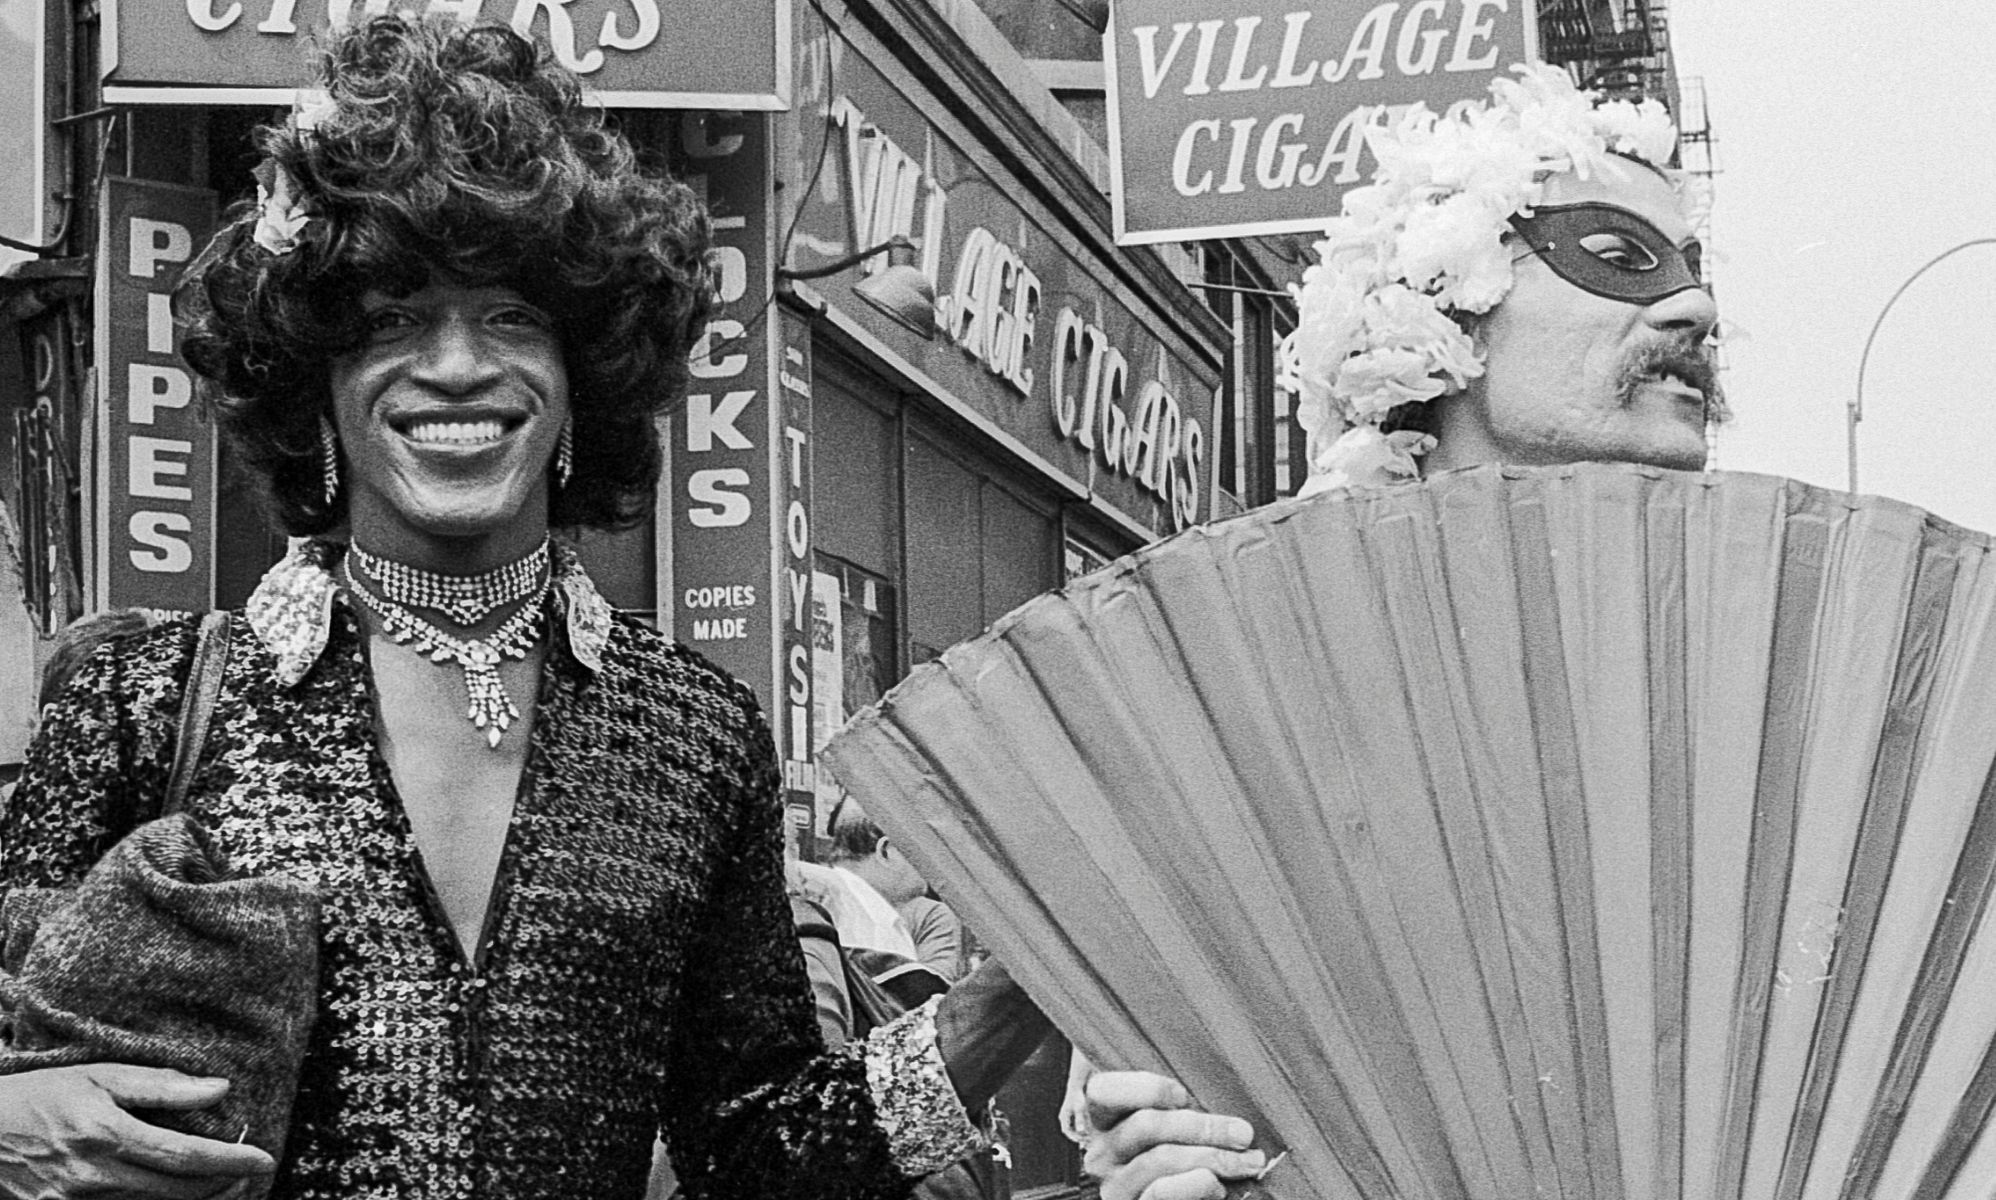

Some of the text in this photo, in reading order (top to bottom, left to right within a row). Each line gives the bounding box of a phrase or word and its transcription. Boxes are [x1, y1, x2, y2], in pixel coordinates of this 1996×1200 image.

[1133, 0, 1507, 99] VILLAGE
[1172, 100, 1488, 197] CIGA
[129, 218, 193, 573] PIPES
[1051, 306, 1203, 532] CIGARS
[685, 585, 756, 608] COPIES
[694, 618, 748, 640] MADE
